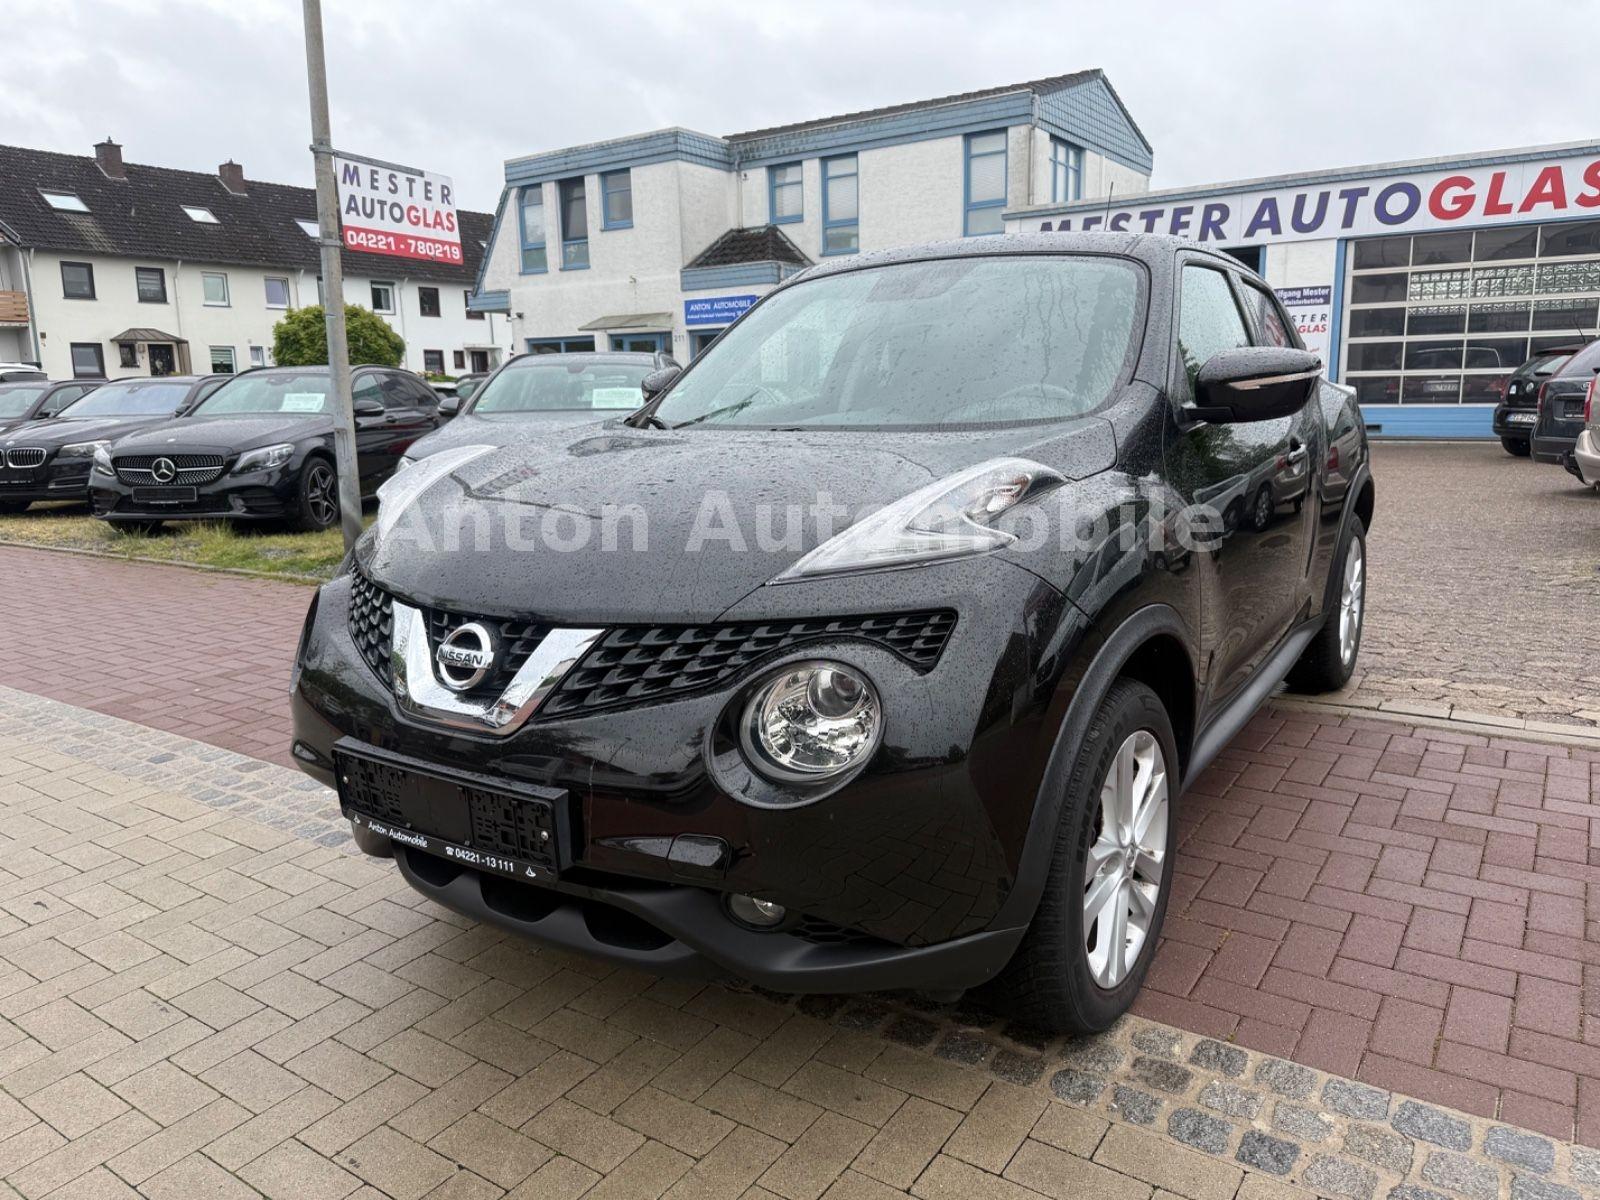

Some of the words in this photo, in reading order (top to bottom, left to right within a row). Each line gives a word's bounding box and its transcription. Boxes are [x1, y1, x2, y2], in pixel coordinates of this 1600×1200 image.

[342, 163, 452, 205] MESTER
[345, 194, 455, 232] AUTOGLAS
[347, 230, 396, 251] 04221
[407, 239, 460, 260] 780219
[1303, 287, 1330, 296] Mester
[689, 302, 711, 312] ANTON
[713, 299, 751, 310] AUTOMOBILE
[1291, 313, 1328, 322] STER
[1297, 324, 1327, 333] GLAS
[439, 647, 483, 666] NISSAN
[368, 820, 388, 836] Anton
[388, 828, 428, 848] Automobile
